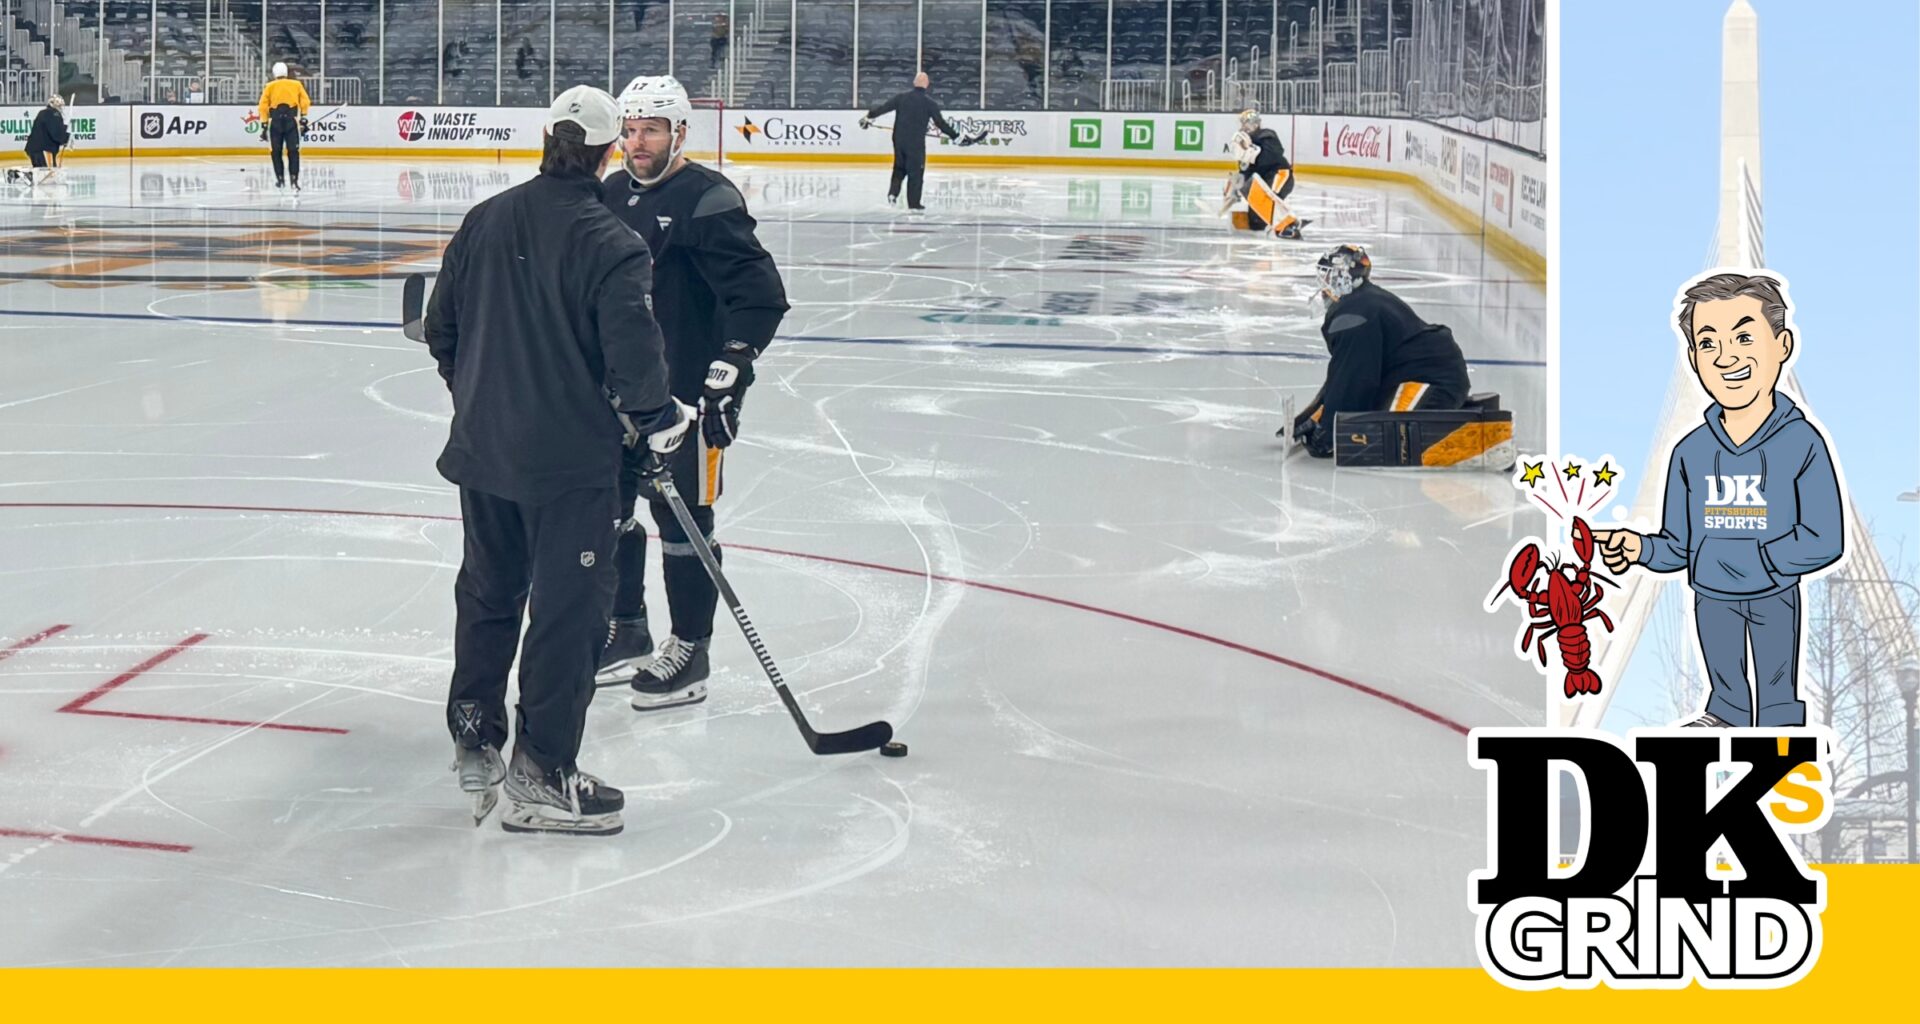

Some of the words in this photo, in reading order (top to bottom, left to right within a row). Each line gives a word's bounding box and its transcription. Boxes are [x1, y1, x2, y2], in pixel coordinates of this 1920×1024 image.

[0, 119, 33, 134] SULLI
[70, 119, 96, 132] TIRE
[433, 113, 477, 125] WASTE
[1073, 124, 1099, 143] TD
[1126, 125, 1150, 144] TD
[1177, 126, 1200, 145] TD
